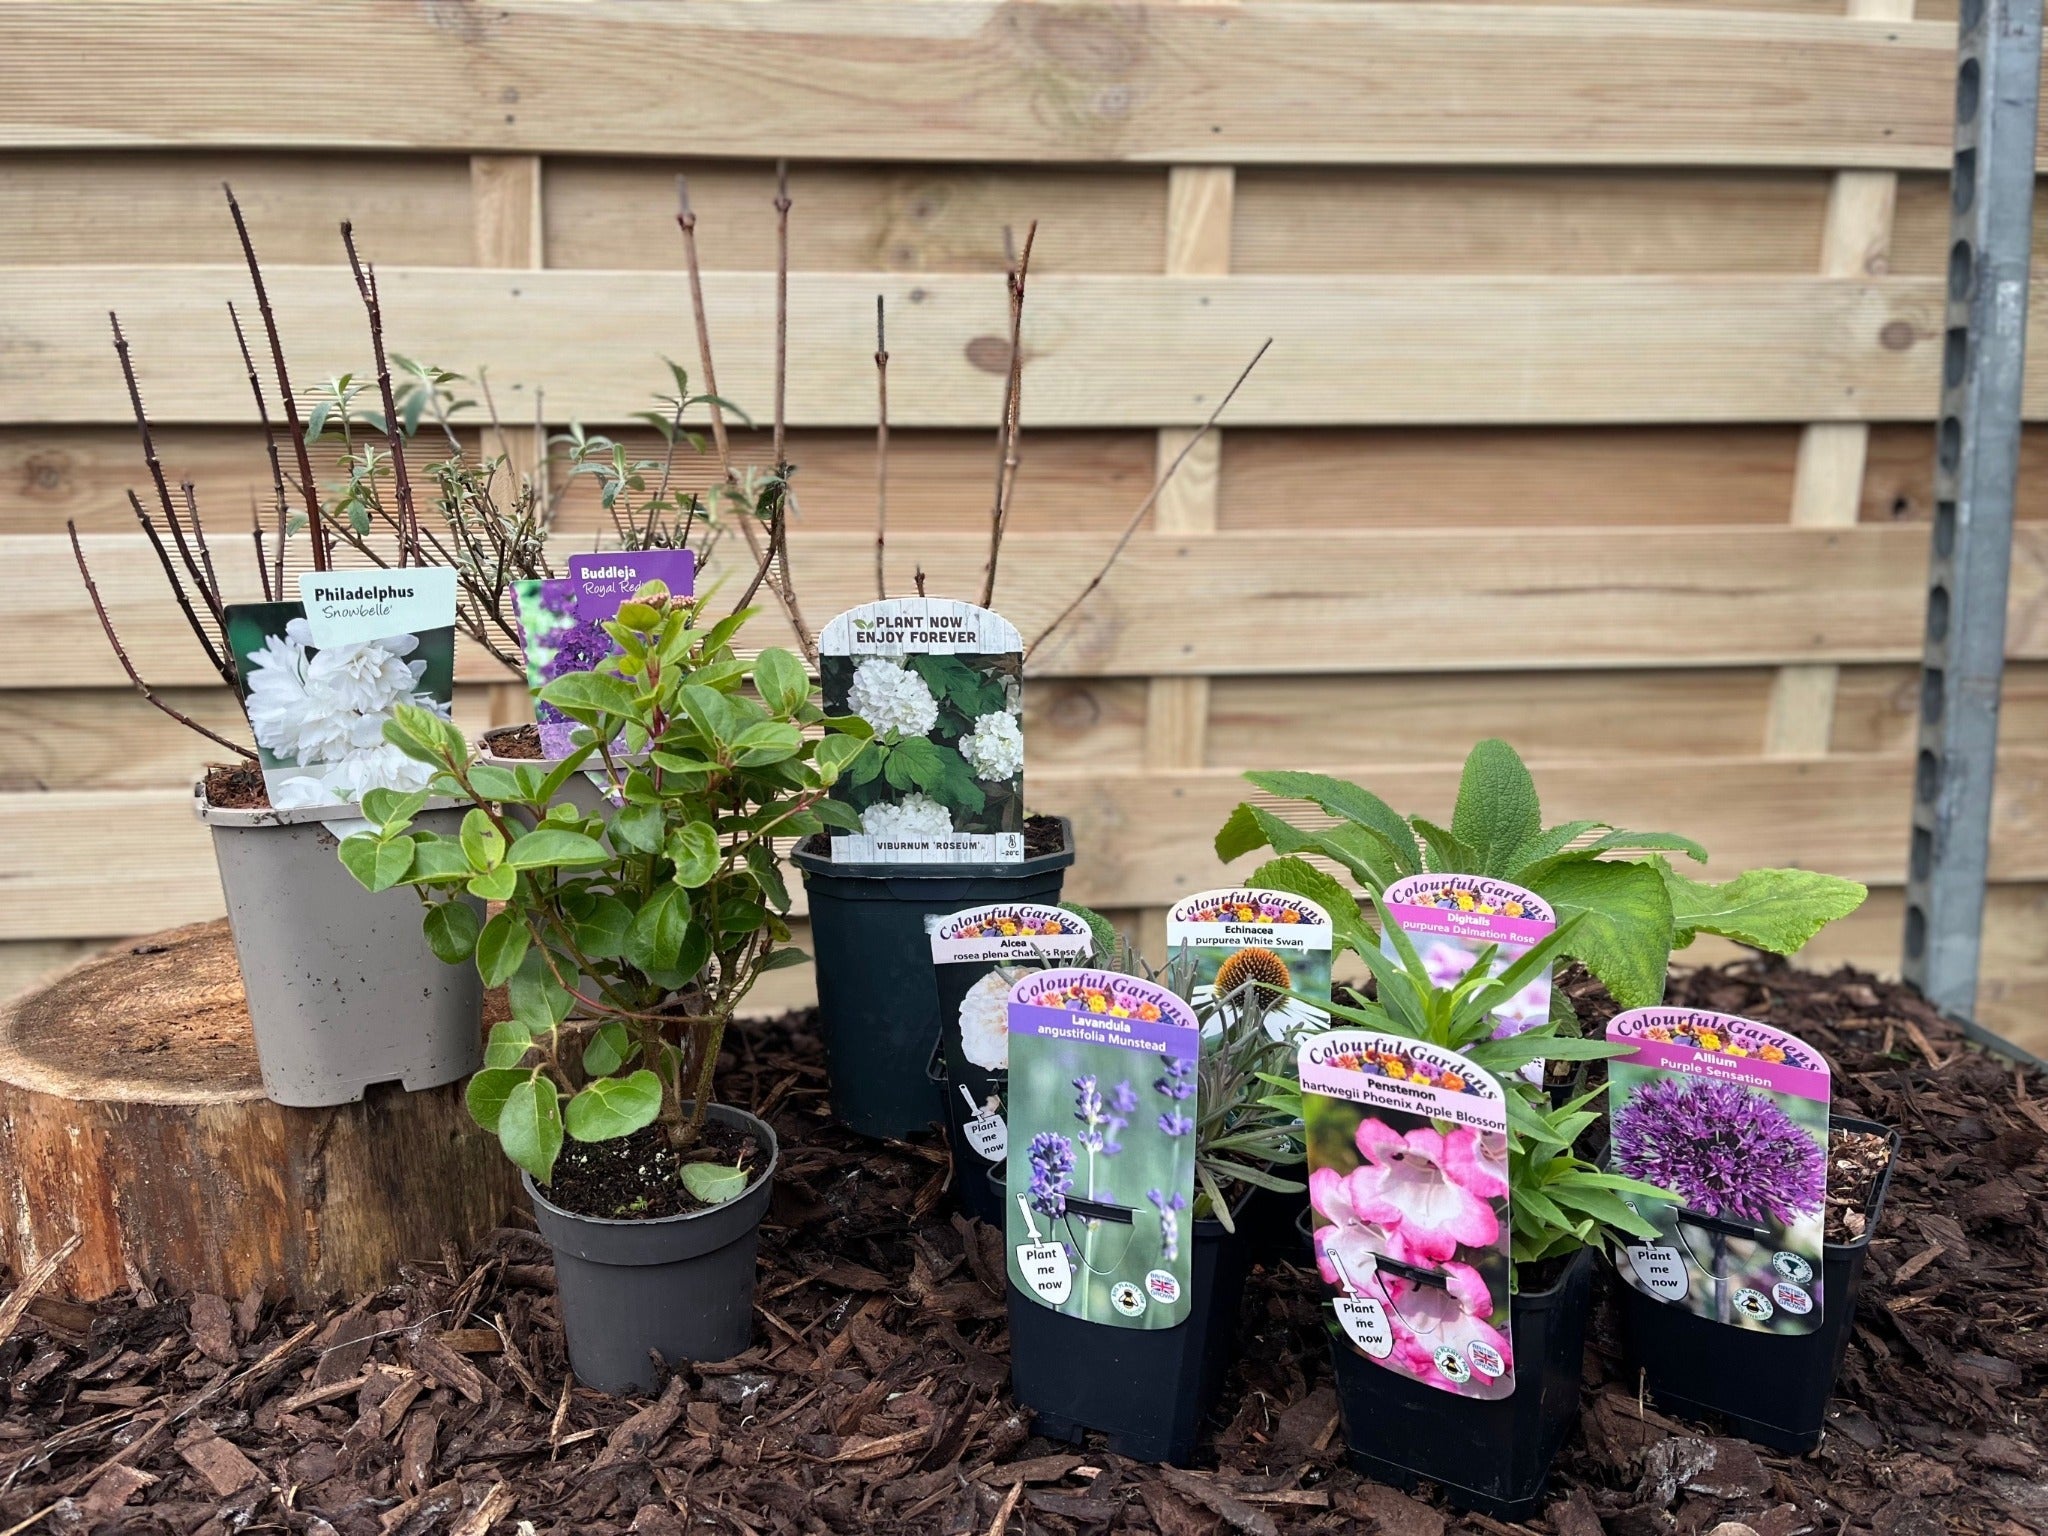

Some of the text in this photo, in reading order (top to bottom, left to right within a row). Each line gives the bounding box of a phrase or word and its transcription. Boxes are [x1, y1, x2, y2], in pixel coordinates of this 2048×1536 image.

[581, 566, 636, 581] Buddleja
[315, 586, 414, 602] Philadelphus
[583, 581, 615, 597] Royal
[876, 617, 962, 628] PLANT NOW
[857, 632, 976, 643] ENJOY FOREVER
[878, 842, 929, 850] VIBURNUM
[1393, 877, 1549, 921] Colourful Gardens
[1175, 892, 1325, 925] Colourful Gardens
[940, 906, 1086, 940] Colourful Gardens
[1447, 913, 1490, 926] Digitalis
[1225, 926, 1273, 934] Echinacea
[1403, 922, 1535, 943] purpurea Dalmation Rose
[1001, 939, 1026, 948] Alcea
[1196, 937, 1303, 946] purpurea White Swan
[954, 952, 980, 960] rosea
[982, 950, 1009, 959] plena
[1012, 949, 1051, 958] Chate's
[1016, 972, 1189, 1028] Colourful Gardens
[1072, 1015, 1131, 1033] Lavandula
[1038, 1024, 1166, 1052] angustifolia Munstead
[1617, 1013, 1820, 1072] Colourful Gardens
[1693, 1051, 1737, 1068] Allium
[1310, 1039, 1497, 1099] Colourful Gardens
[1661, 1058, 1772, 1088] Purple Sensation
[1367, 1079, 1436, 1101] Penstemon
[1303, 1079, 1359, 1098] hartwegii
[1363, 1087, 1412, 1109] Phoenix
[1416, 1102, 1452, 1119] Apple
[972, 1121, 997, 1133] Plant
[982, 1134, 996, 1142] me
[984, 1144, 1003, 1154] now
[1027, 1250, 1056, 1260] Plant
[1638, 1252, 1671, 1260] Plant
[1038, 1266, 1054, 1274] me
[1038, 1282, 1062, 1290] now
[1344, 1304, 1374, 1313] Plant
[1356, 1320, 1373, 1328] me
